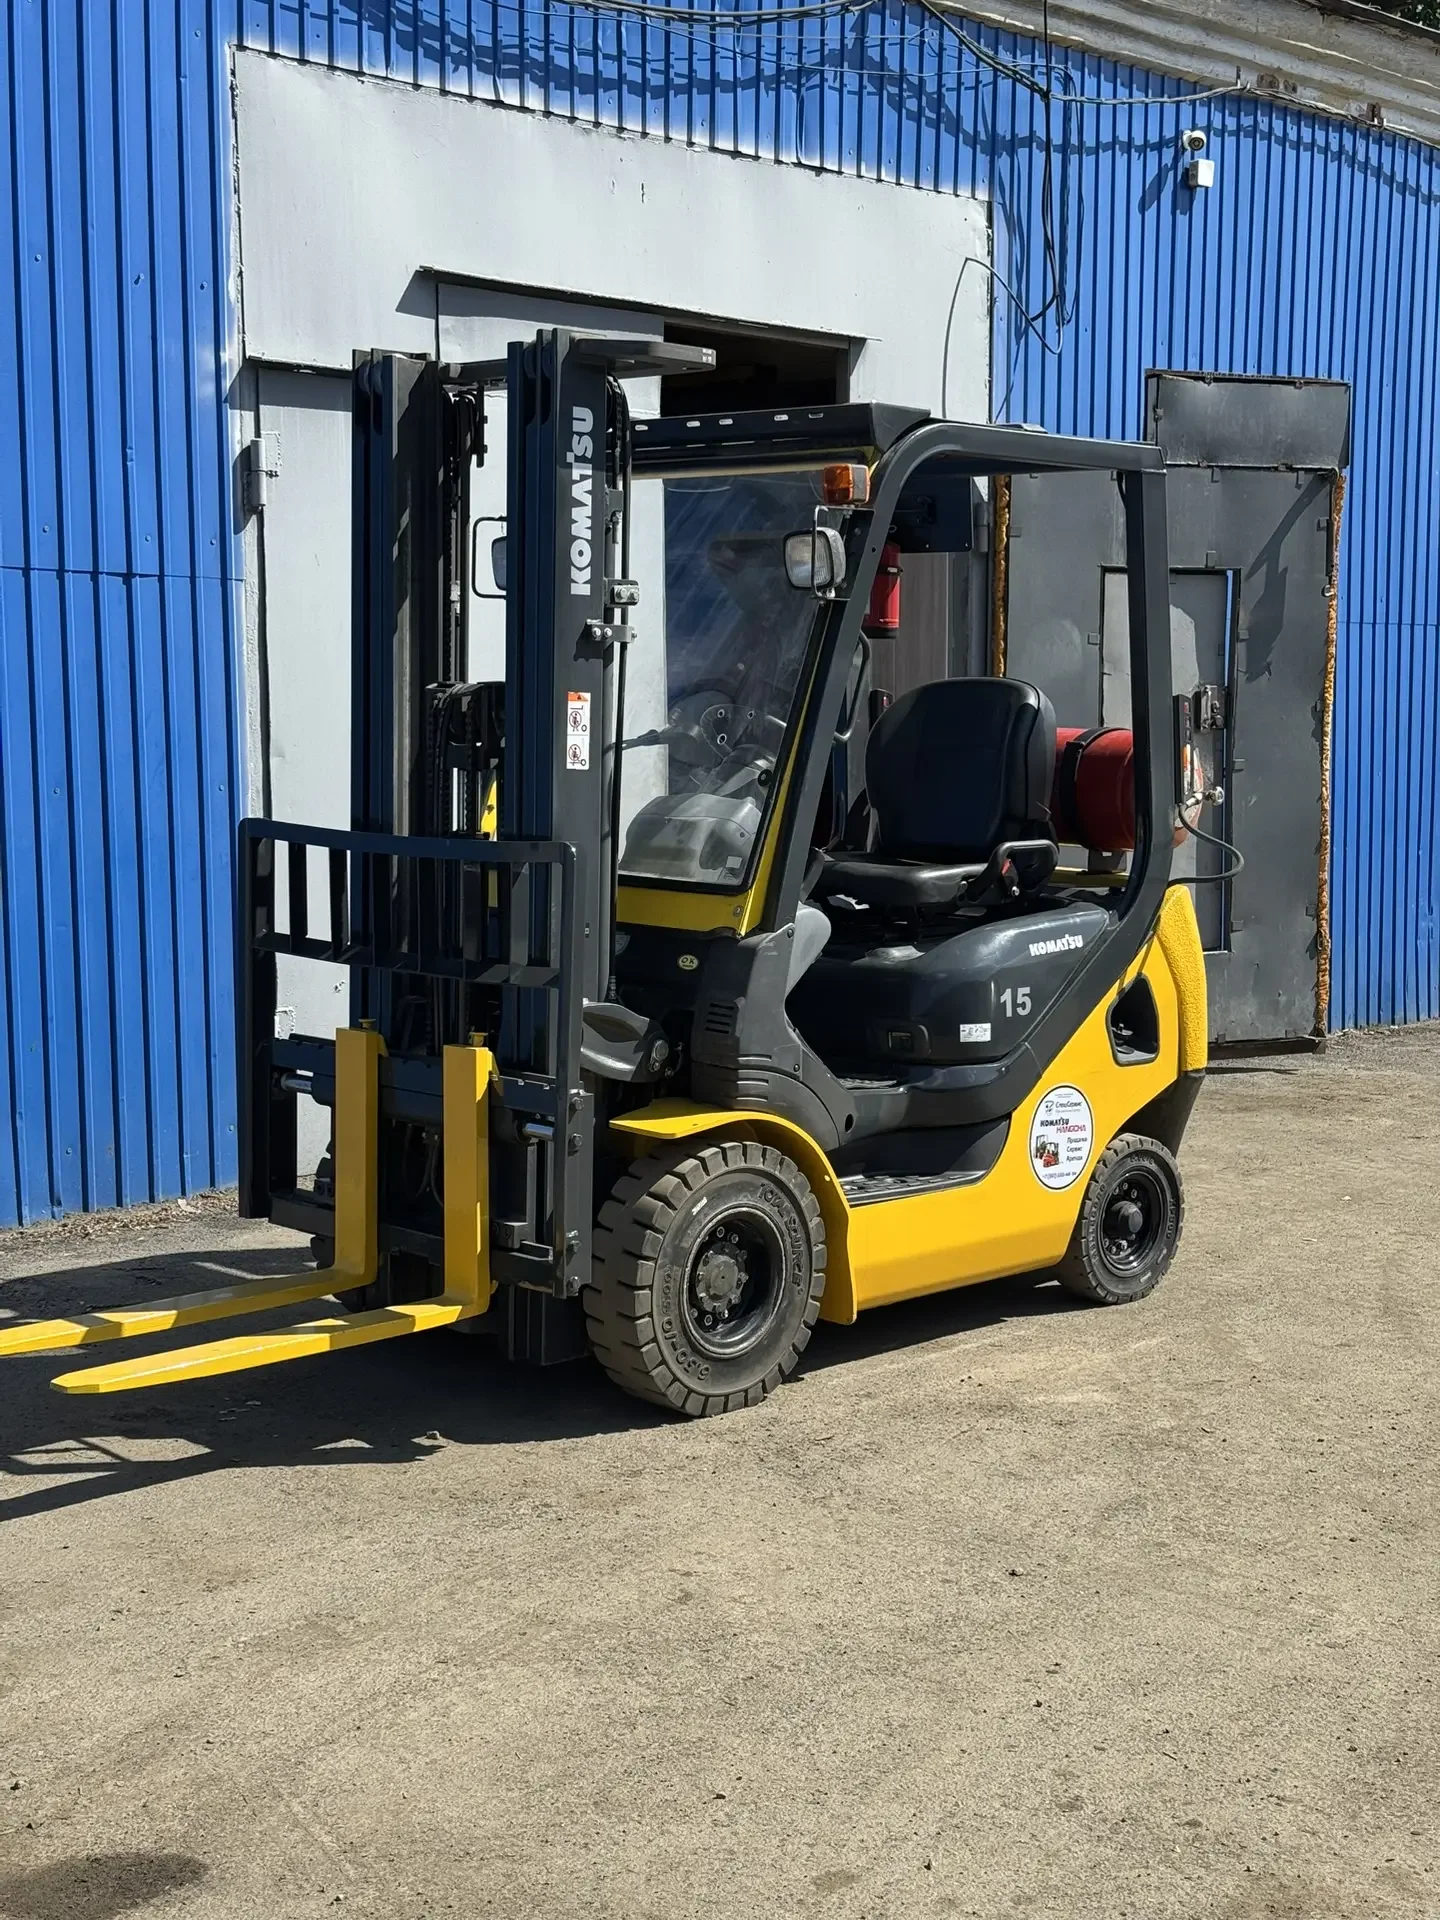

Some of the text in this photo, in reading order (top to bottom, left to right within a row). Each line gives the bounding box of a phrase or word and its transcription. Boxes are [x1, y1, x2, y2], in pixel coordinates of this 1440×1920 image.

[566, 406, 594, 596] KOMATSU
[1028, 934, 1084, 956] KOMATSU
[1000, 986, 1032, 1018] 15
[1040, 1117, 1070, 1128] KOMATSU
